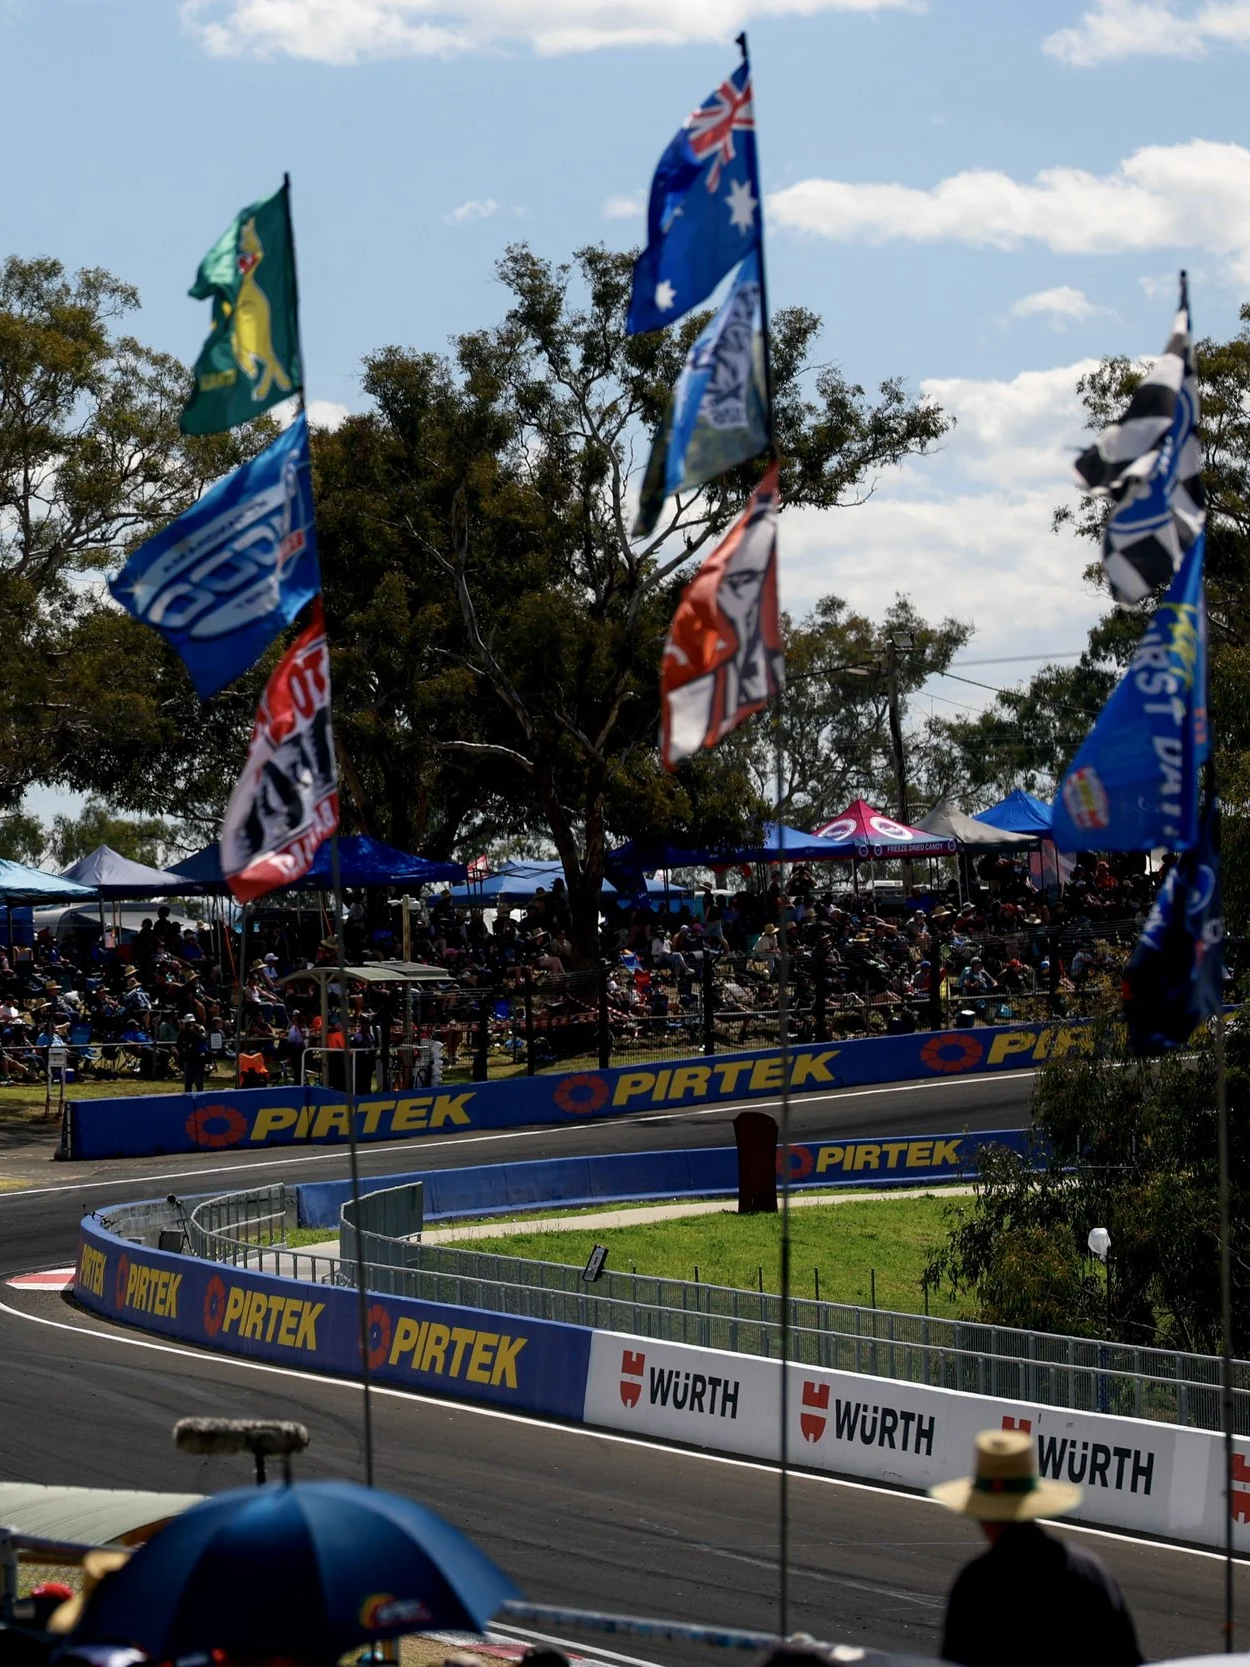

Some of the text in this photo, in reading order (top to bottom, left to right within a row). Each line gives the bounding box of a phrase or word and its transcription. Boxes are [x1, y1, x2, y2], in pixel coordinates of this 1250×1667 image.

[908, 844, 924, 852] DRIED
[925, 843, 944, 851] CANDY
[612, 1050, 840, 1105] PIRTEK
[250, 1093, 476, 1141] PIRTEK
[816, 1140, 962, 1172] PIRTEK
[79, 1244, 106, 1297] PIRTEK
[125, 1263, 182, 1319] PIRTEK
[223, 1287, 325, 1350] PIRTEK
[389, 1317, 528, 1390] PIRTEK
